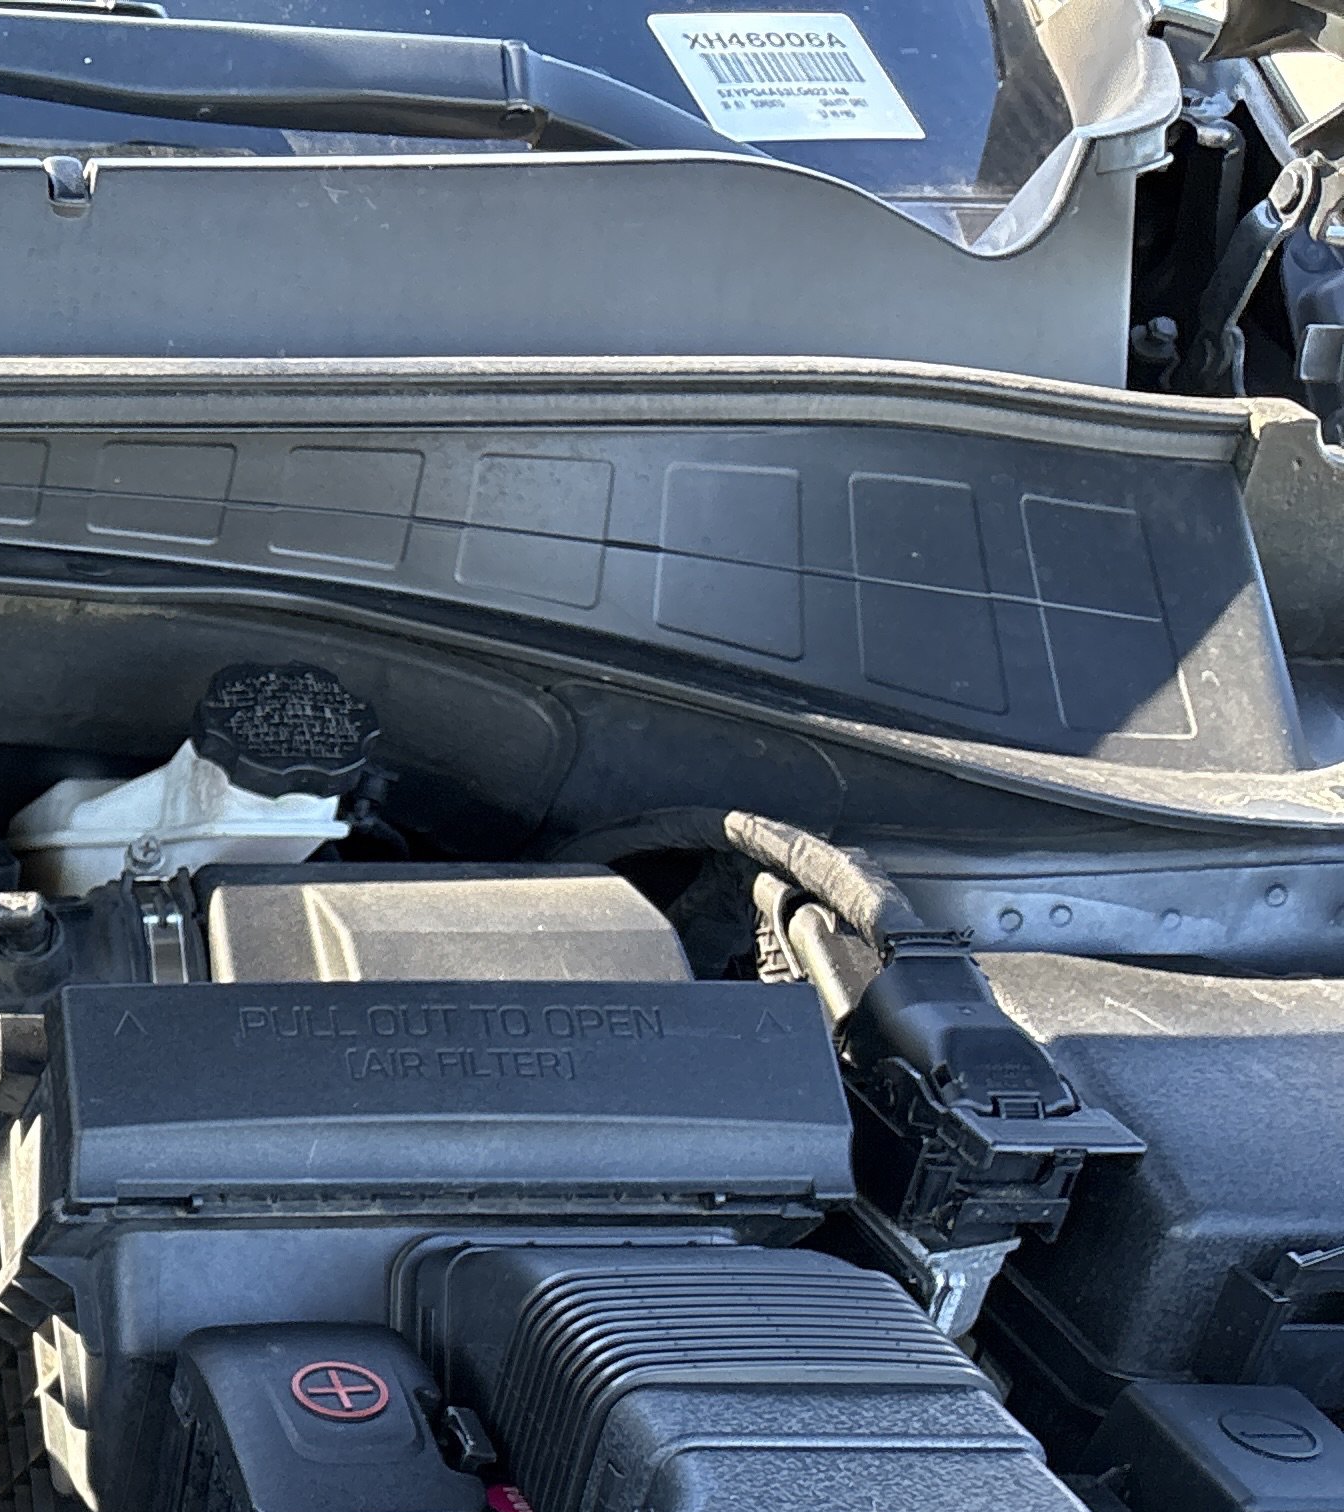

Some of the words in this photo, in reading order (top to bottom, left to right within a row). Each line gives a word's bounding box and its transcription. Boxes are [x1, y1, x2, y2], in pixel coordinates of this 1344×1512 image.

[682, 32, 847, 50] XH46006A
[237, 1005, 358, 1039] PULL
[367, 1005, 459, 1039] OUT
[469, 1005, 532, 1039] TO
[542, 1005, 666, 1039] OPEN
